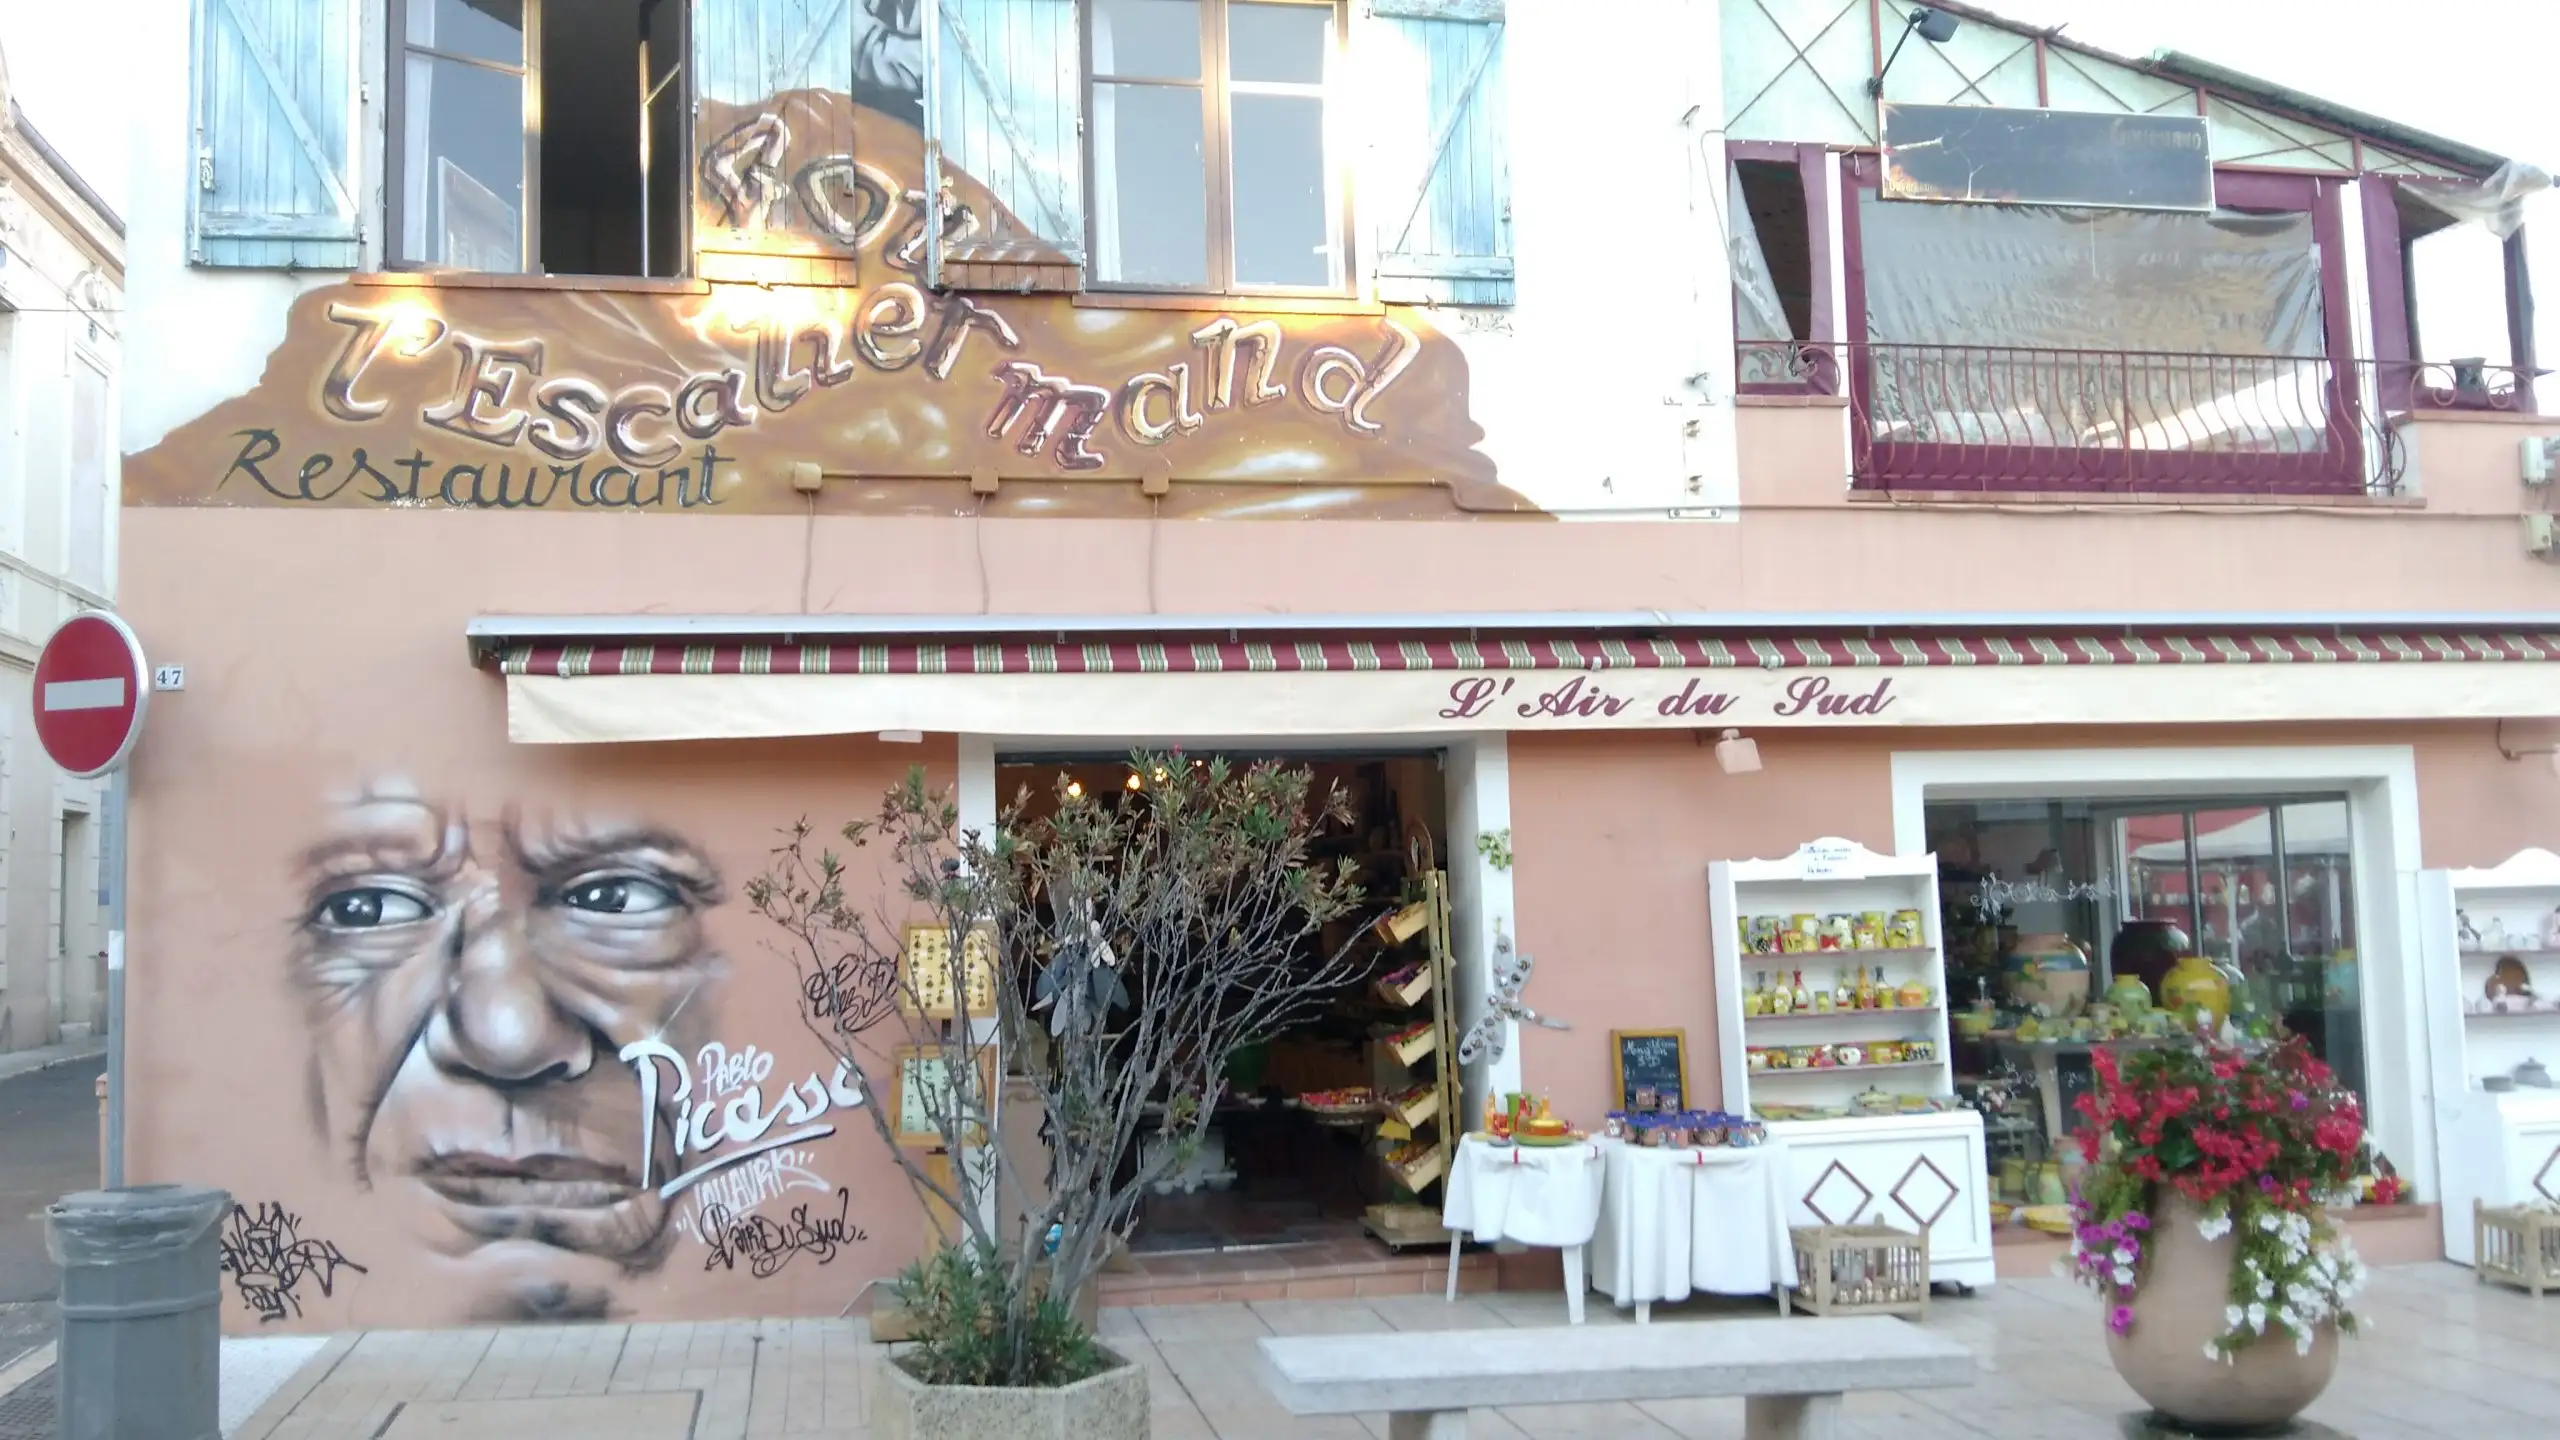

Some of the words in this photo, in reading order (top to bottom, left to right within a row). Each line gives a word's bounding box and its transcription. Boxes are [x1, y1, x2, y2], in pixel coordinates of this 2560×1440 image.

[219, 428, 736, 508] Restaurant
[157, 670, 182, 685] 47
[1438, 675, 1635, 719] L'Air
[1657, 677, 1740, 717] du
[1772, 675, 1897, 717] Sud
[619, 1039, 865, 1190] Picasso
